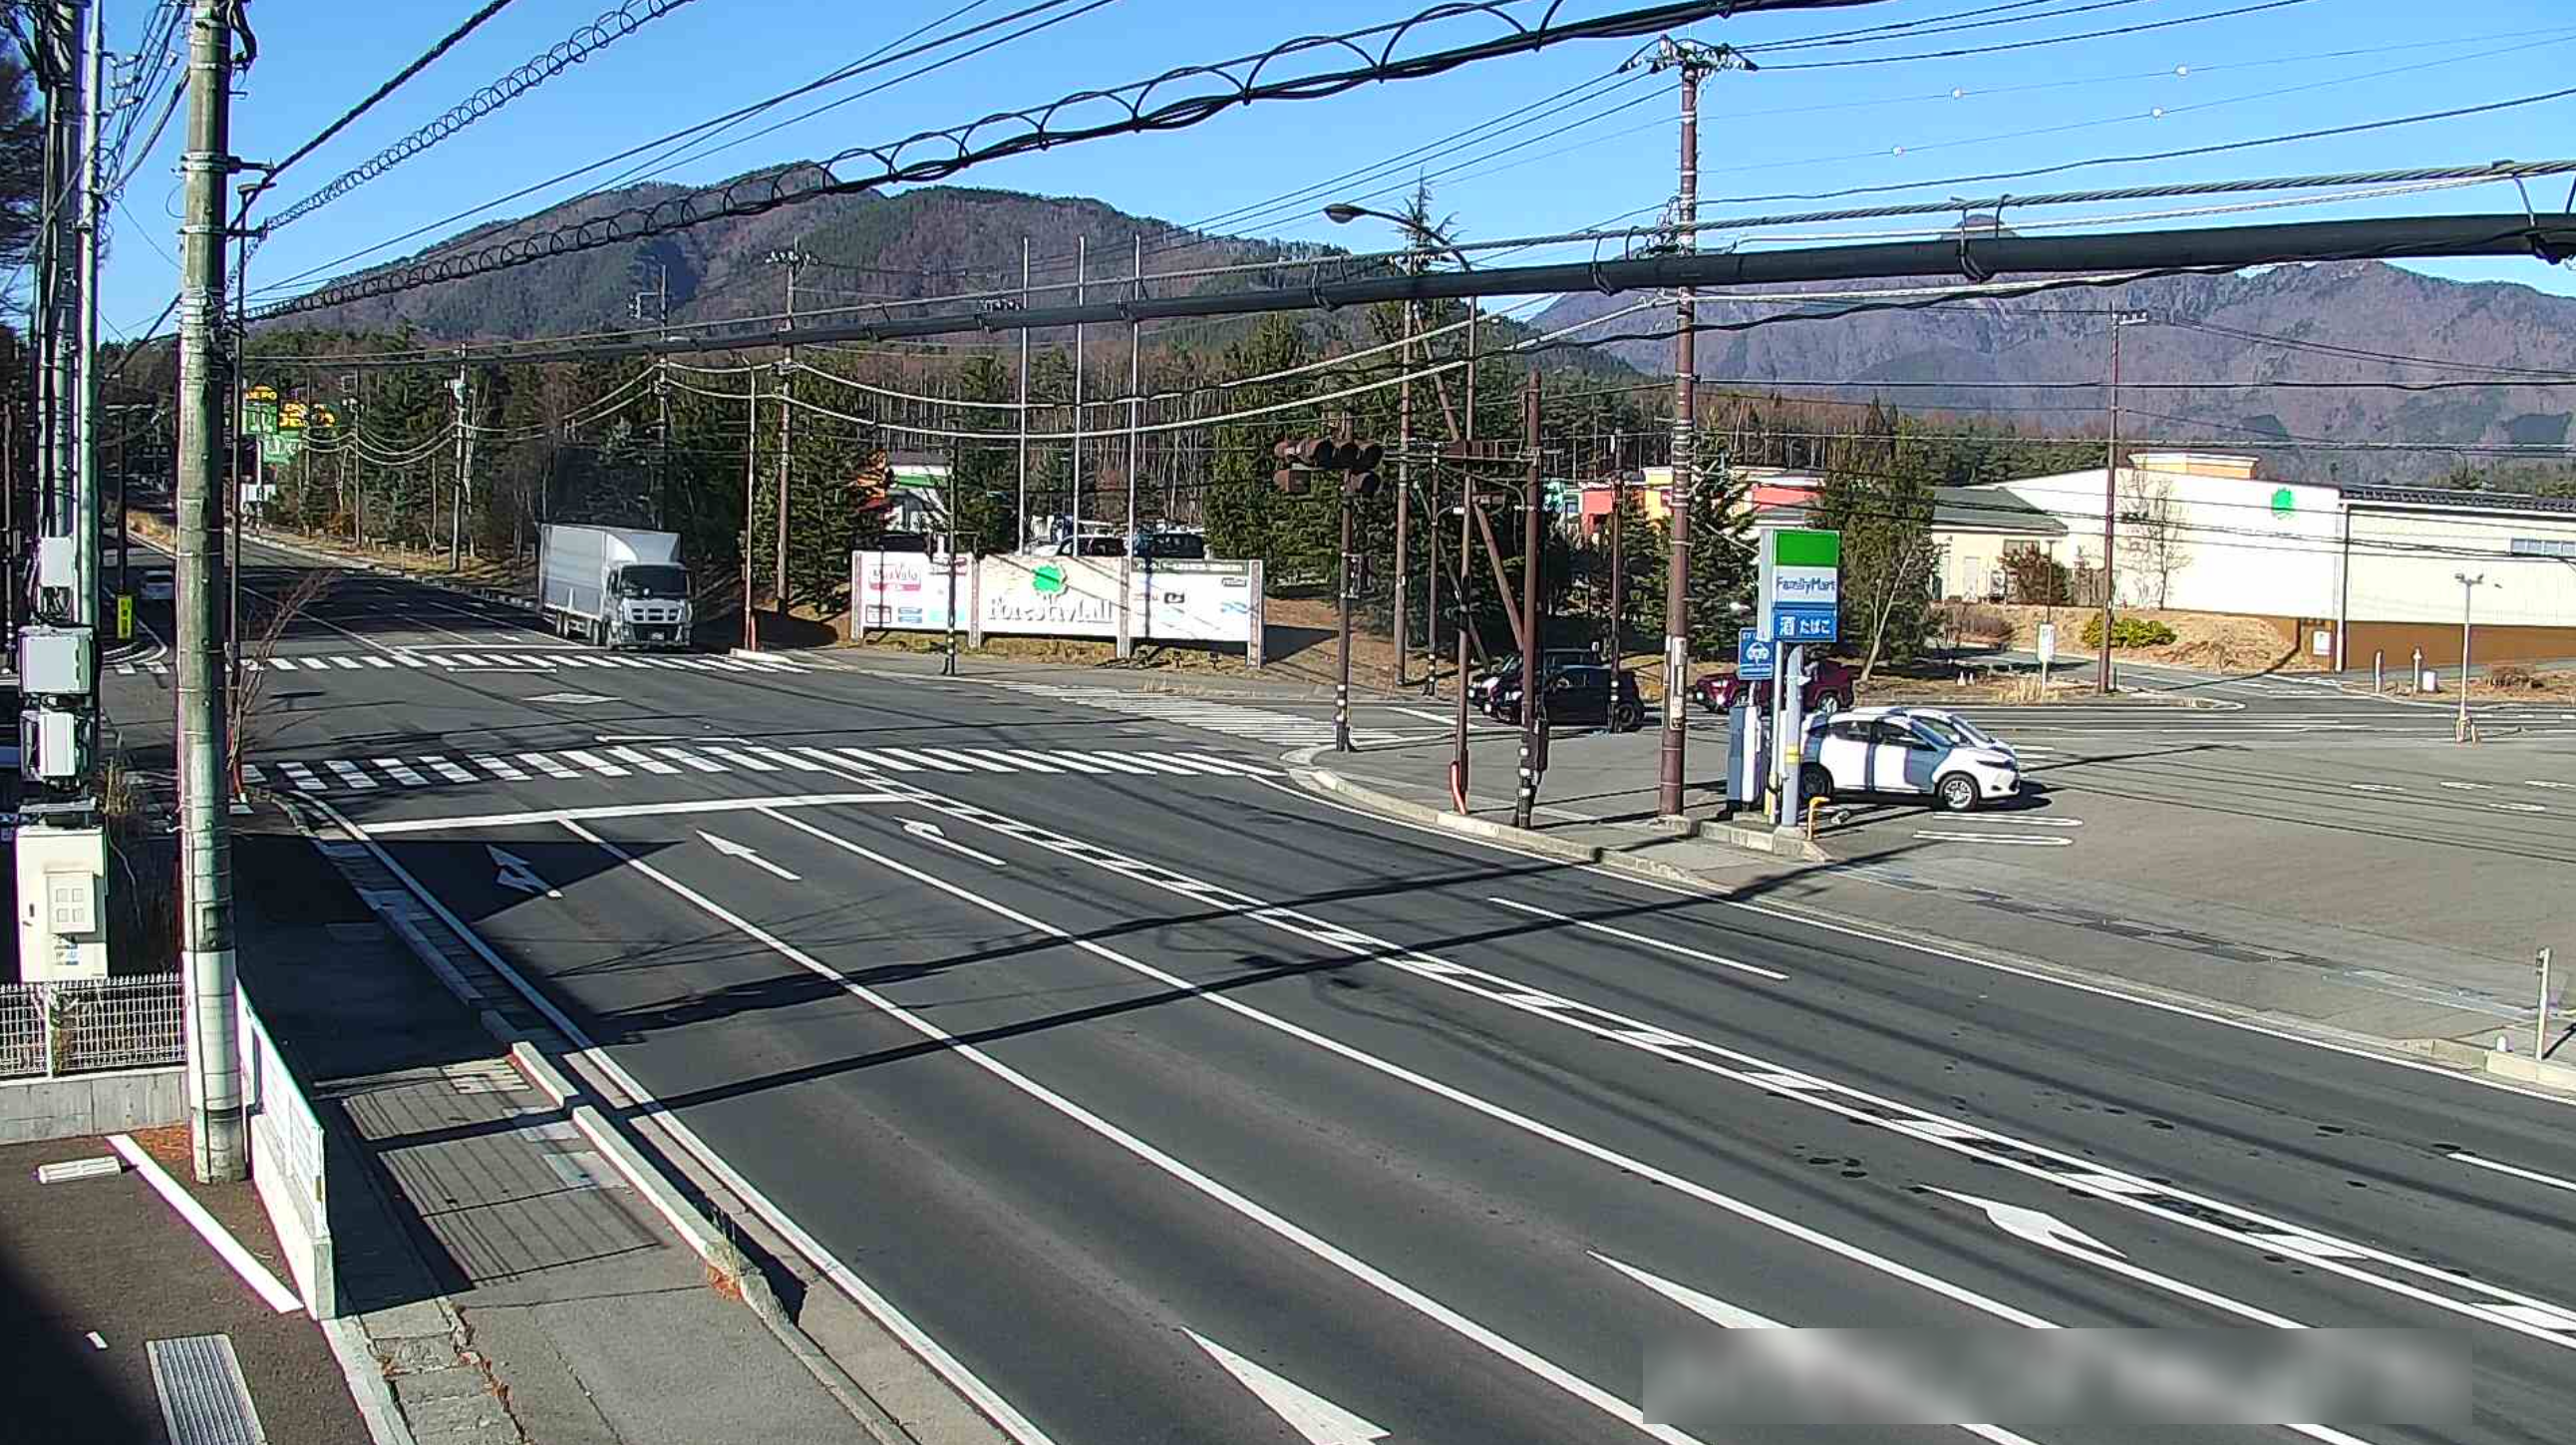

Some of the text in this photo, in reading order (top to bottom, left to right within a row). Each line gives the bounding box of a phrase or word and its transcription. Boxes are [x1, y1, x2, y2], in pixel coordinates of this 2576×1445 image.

[1777, 577, 1835, 594] FamilyMart
[1778, 615, 1795, 636] 酒
[1799, 618, 1831, 635] たばこ
